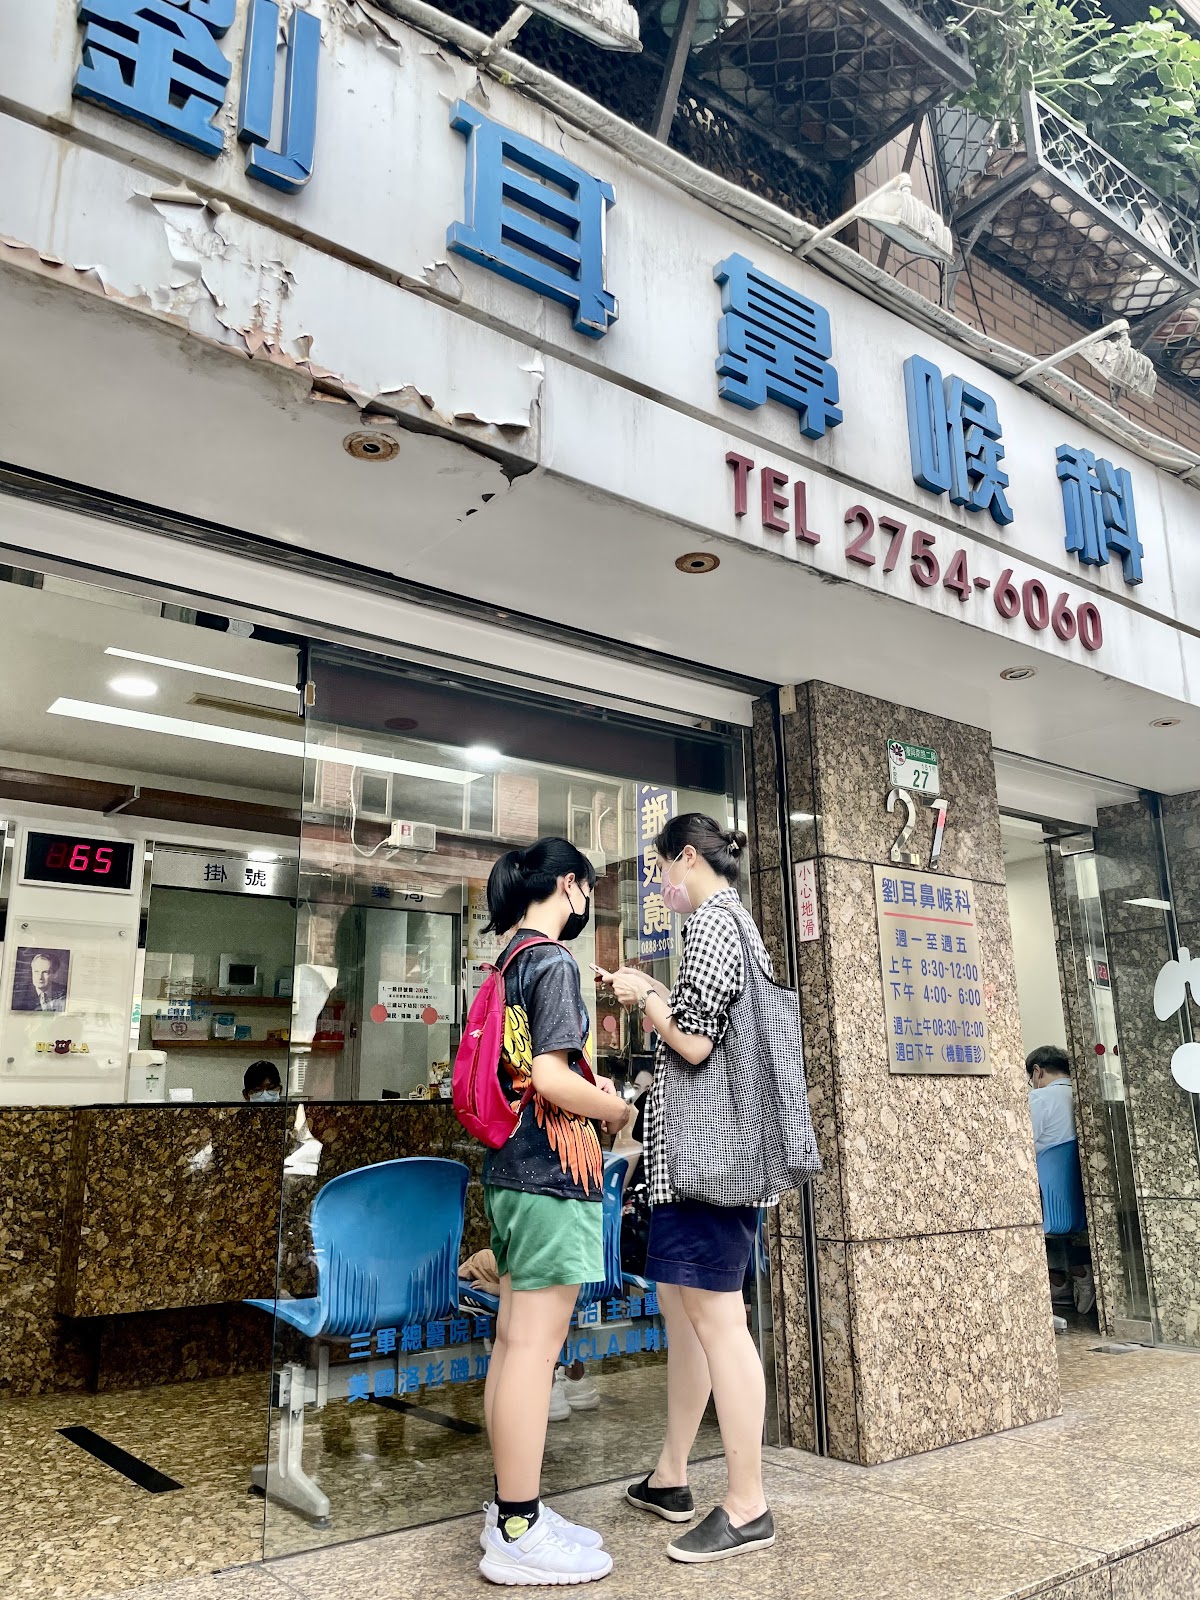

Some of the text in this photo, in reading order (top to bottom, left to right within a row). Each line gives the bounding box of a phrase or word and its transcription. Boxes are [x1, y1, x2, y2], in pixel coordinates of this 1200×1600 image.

[725, 451, 1103, 652] TEL 2754-6060
[912, 769, 930, 790] 27
[887, 788, 949, 869] 27
[69, 844, 114, 874] 65
[203, 863, 267, 887] 掛號
[798, 865, 816, 937] 小心地滑
[881, 877, 972, 915] 劉耳鼻喉科
[895, 928, 968, 954] 週一至週五
[889, 955, 913, 975] 上午
[889, 981, 915, 1002] 下午
[958, 987, 981, 1007] 6:00
[895, 1042, 935, 1063] 週日下午
[348, 1314, 492, 1359] 三軍總醫院耳
